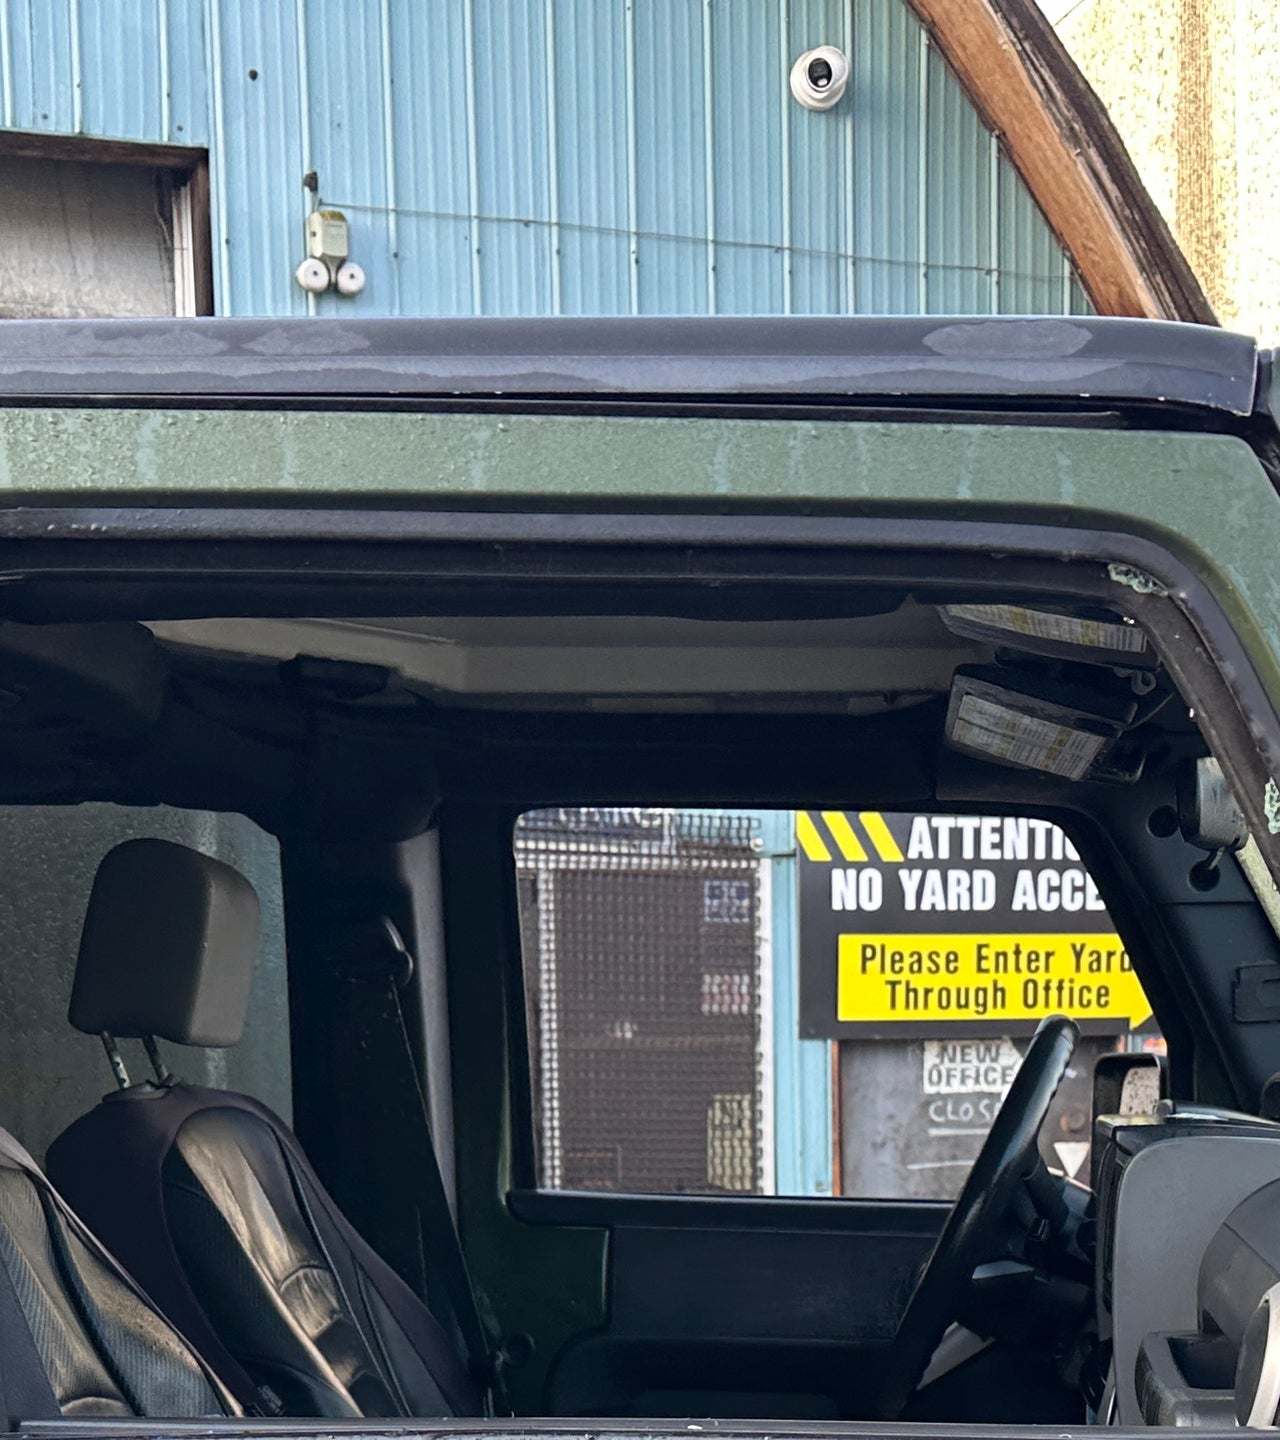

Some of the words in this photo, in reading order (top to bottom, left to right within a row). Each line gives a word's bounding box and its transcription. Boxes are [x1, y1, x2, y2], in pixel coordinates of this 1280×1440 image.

[831, 868, 883, 912] NO
[898, 868, 997, 912] YARD
[861, 943, 960, 975] Please
[976, 943, 1056, 974] Enter
[885, 979, 1007, 1016] Through
[1023, 978, 1111, 1009] Office
[939, 1043, 999, 1064] NEW
[928, 1064, 1013, 1087] OFFICE
